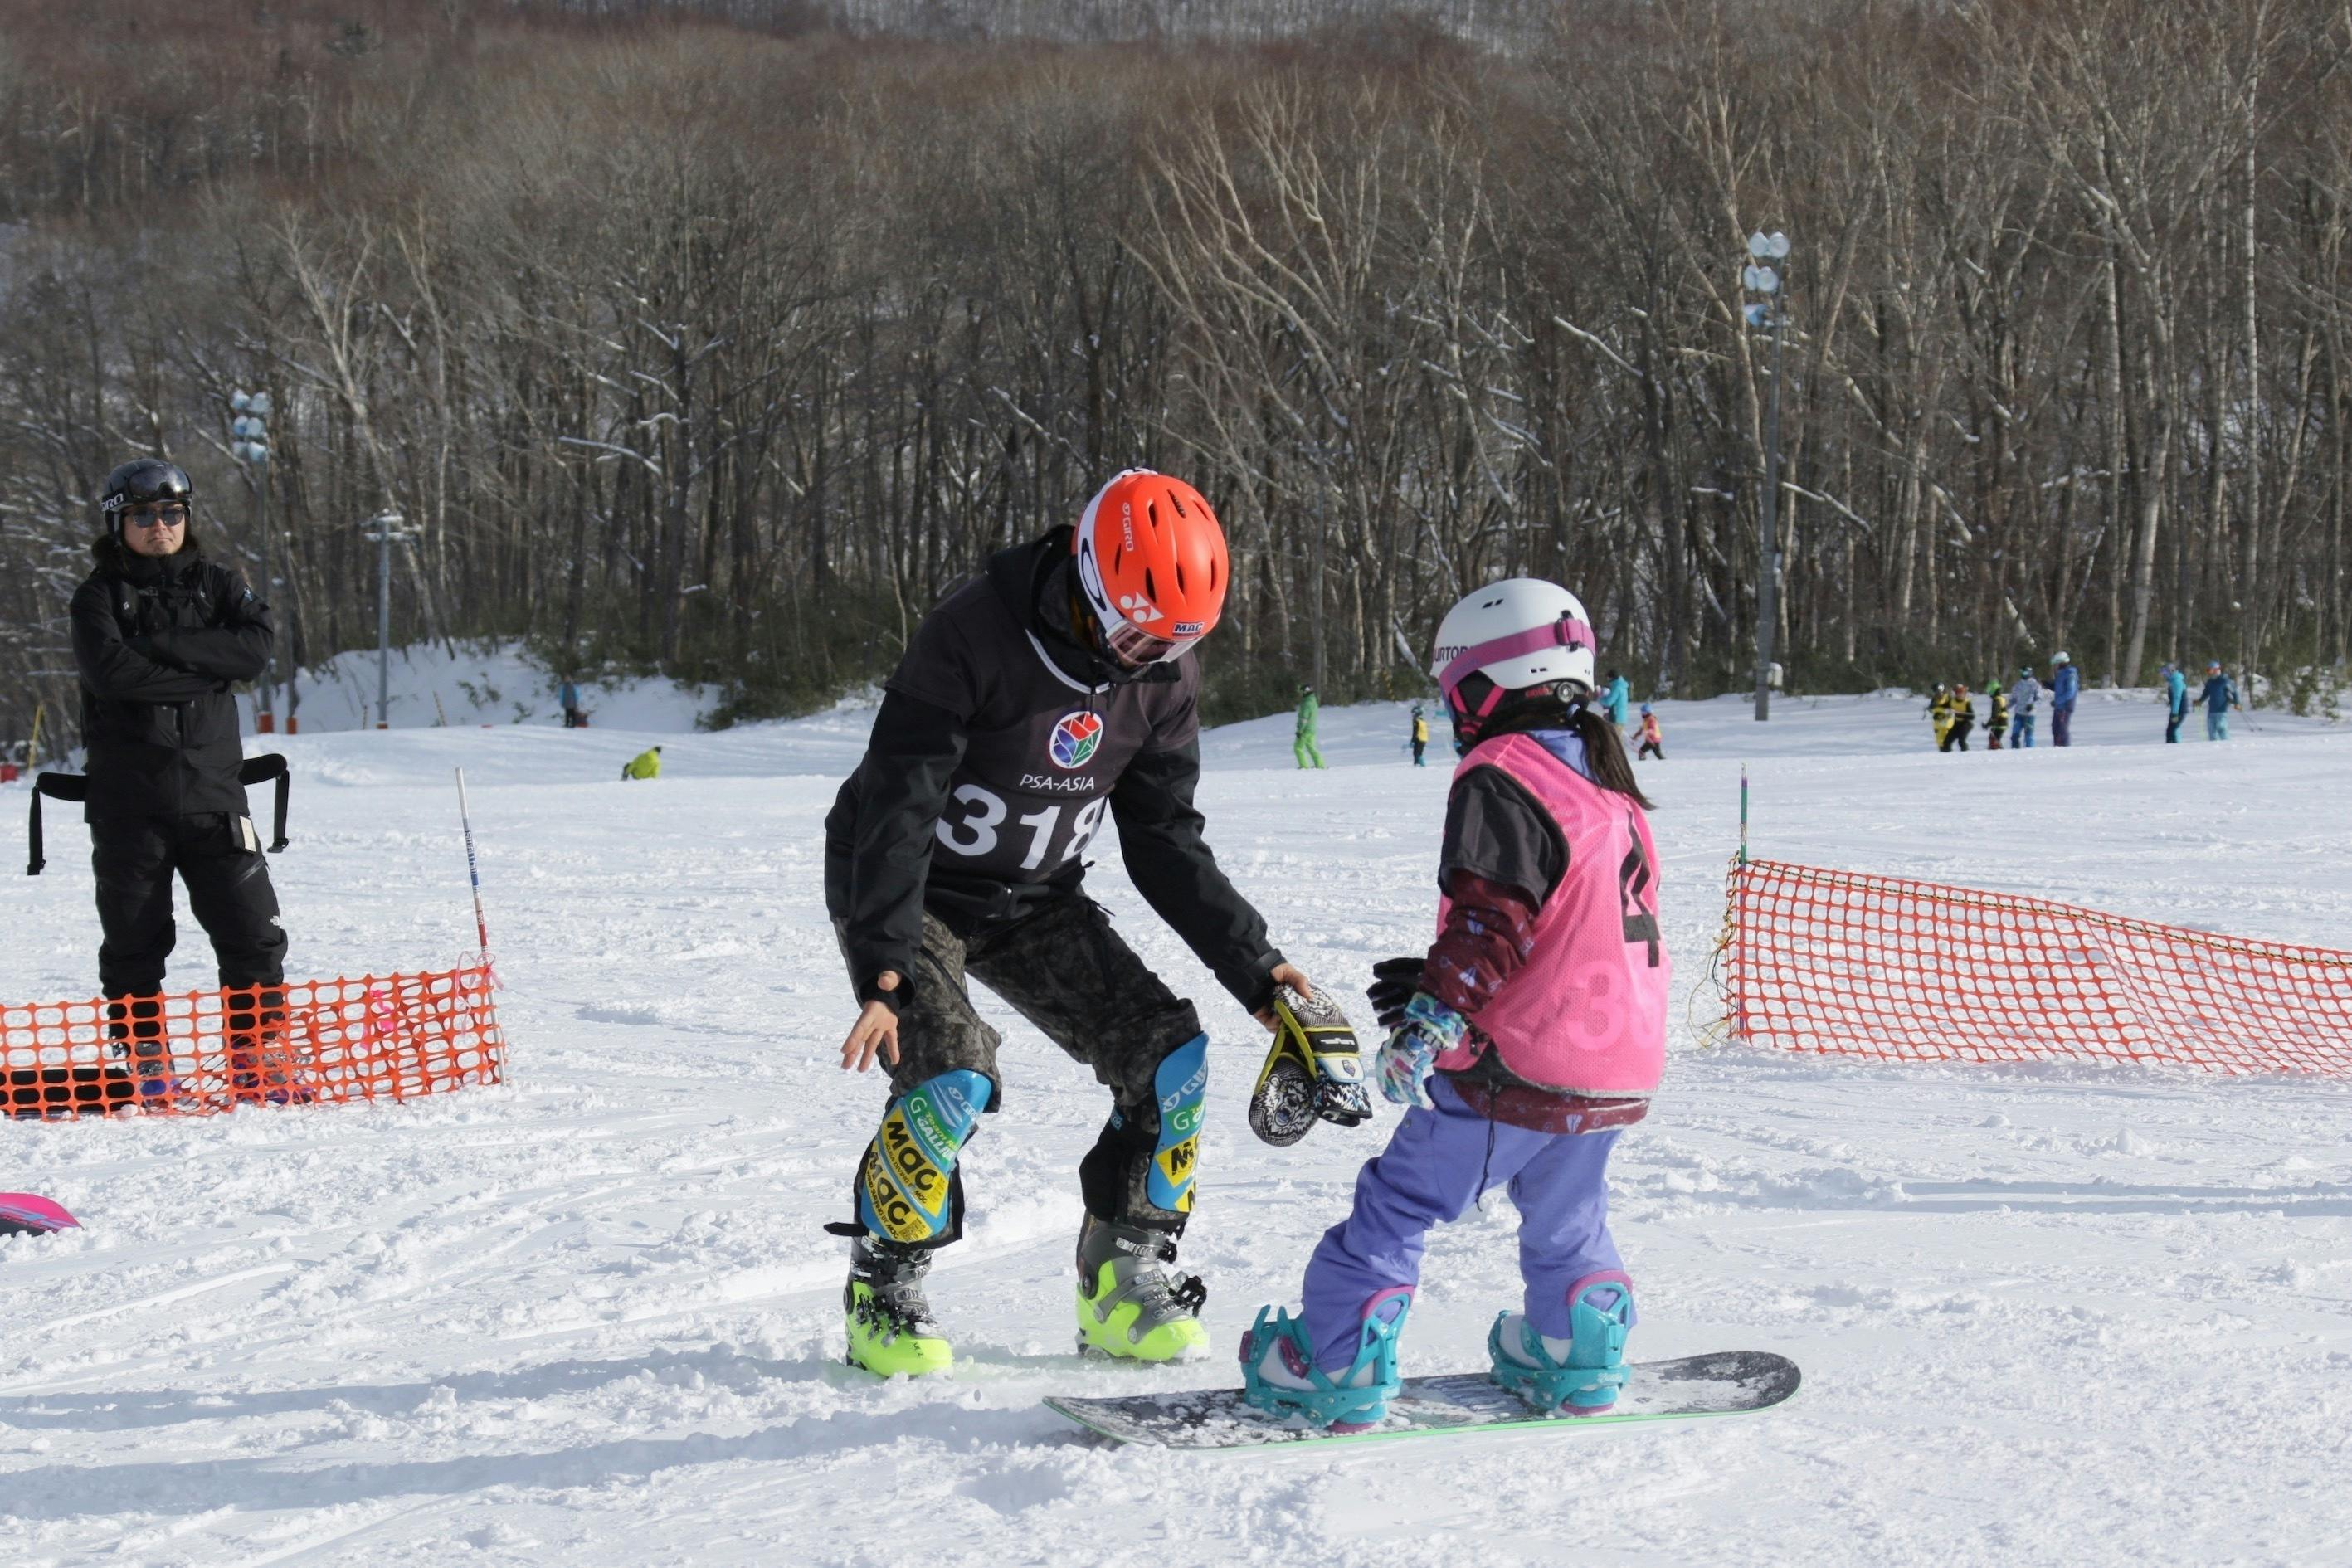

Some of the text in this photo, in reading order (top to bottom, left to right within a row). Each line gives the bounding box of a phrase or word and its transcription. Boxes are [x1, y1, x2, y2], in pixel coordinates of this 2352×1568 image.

[1122, 517, 1134, 552] GIRO
[1175, 623, 1203, 632] MAC
[1019, 774, 1095, 791] PSA-ASIA
[936, 783, 1102, 870] 318
